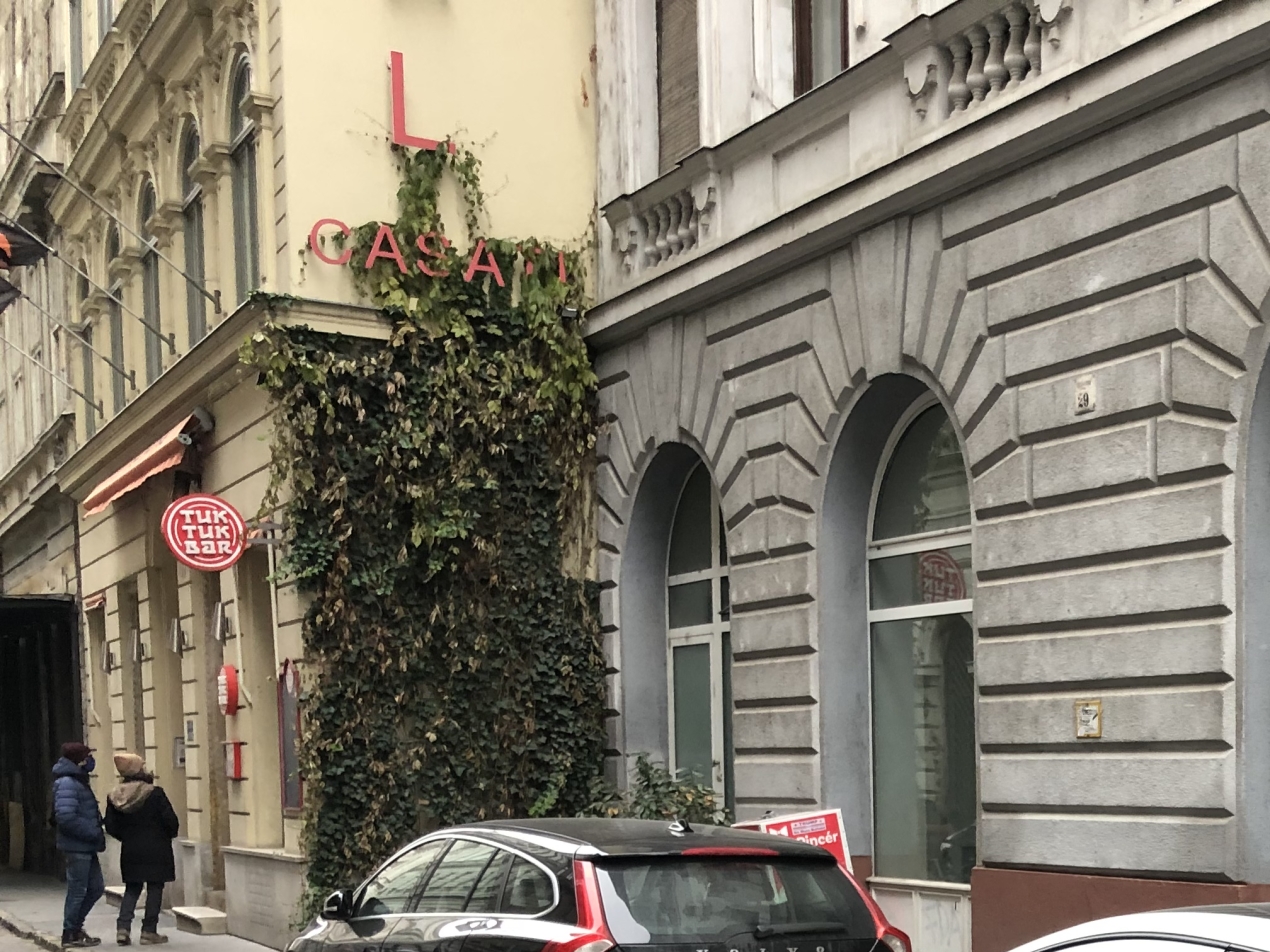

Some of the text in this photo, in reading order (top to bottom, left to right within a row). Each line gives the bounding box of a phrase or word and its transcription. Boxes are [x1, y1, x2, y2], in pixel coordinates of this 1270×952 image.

[390, 50, 456, 155] L
[179, 509, 229, 524] TUK
[181, 525, 231, 539] TUK
